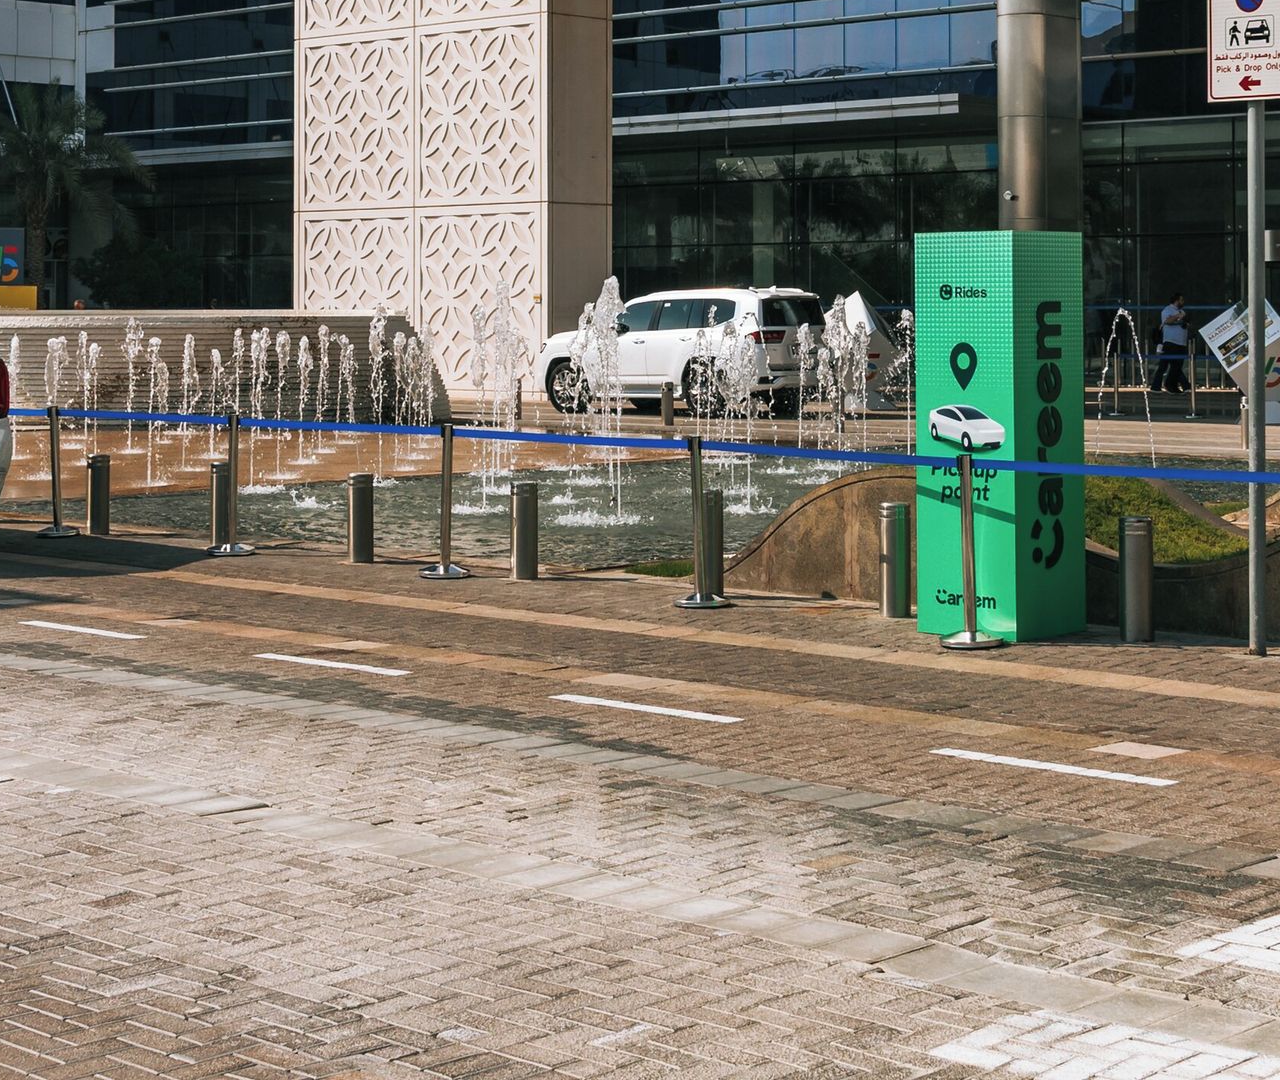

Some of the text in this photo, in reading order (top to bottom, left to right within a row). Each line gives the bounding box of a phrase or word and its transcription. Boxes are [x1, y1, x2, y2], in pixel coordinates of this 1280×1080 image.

[1216, 65, 1231, 73] Pick
[1235, 64, 1241, 72] &
[1244, 64, 1262, 72] Drop
[954, 286, 987, 298] Rides
[1031, 301, 1064, 570] Careem
[941, 485, 990, 503] pont
